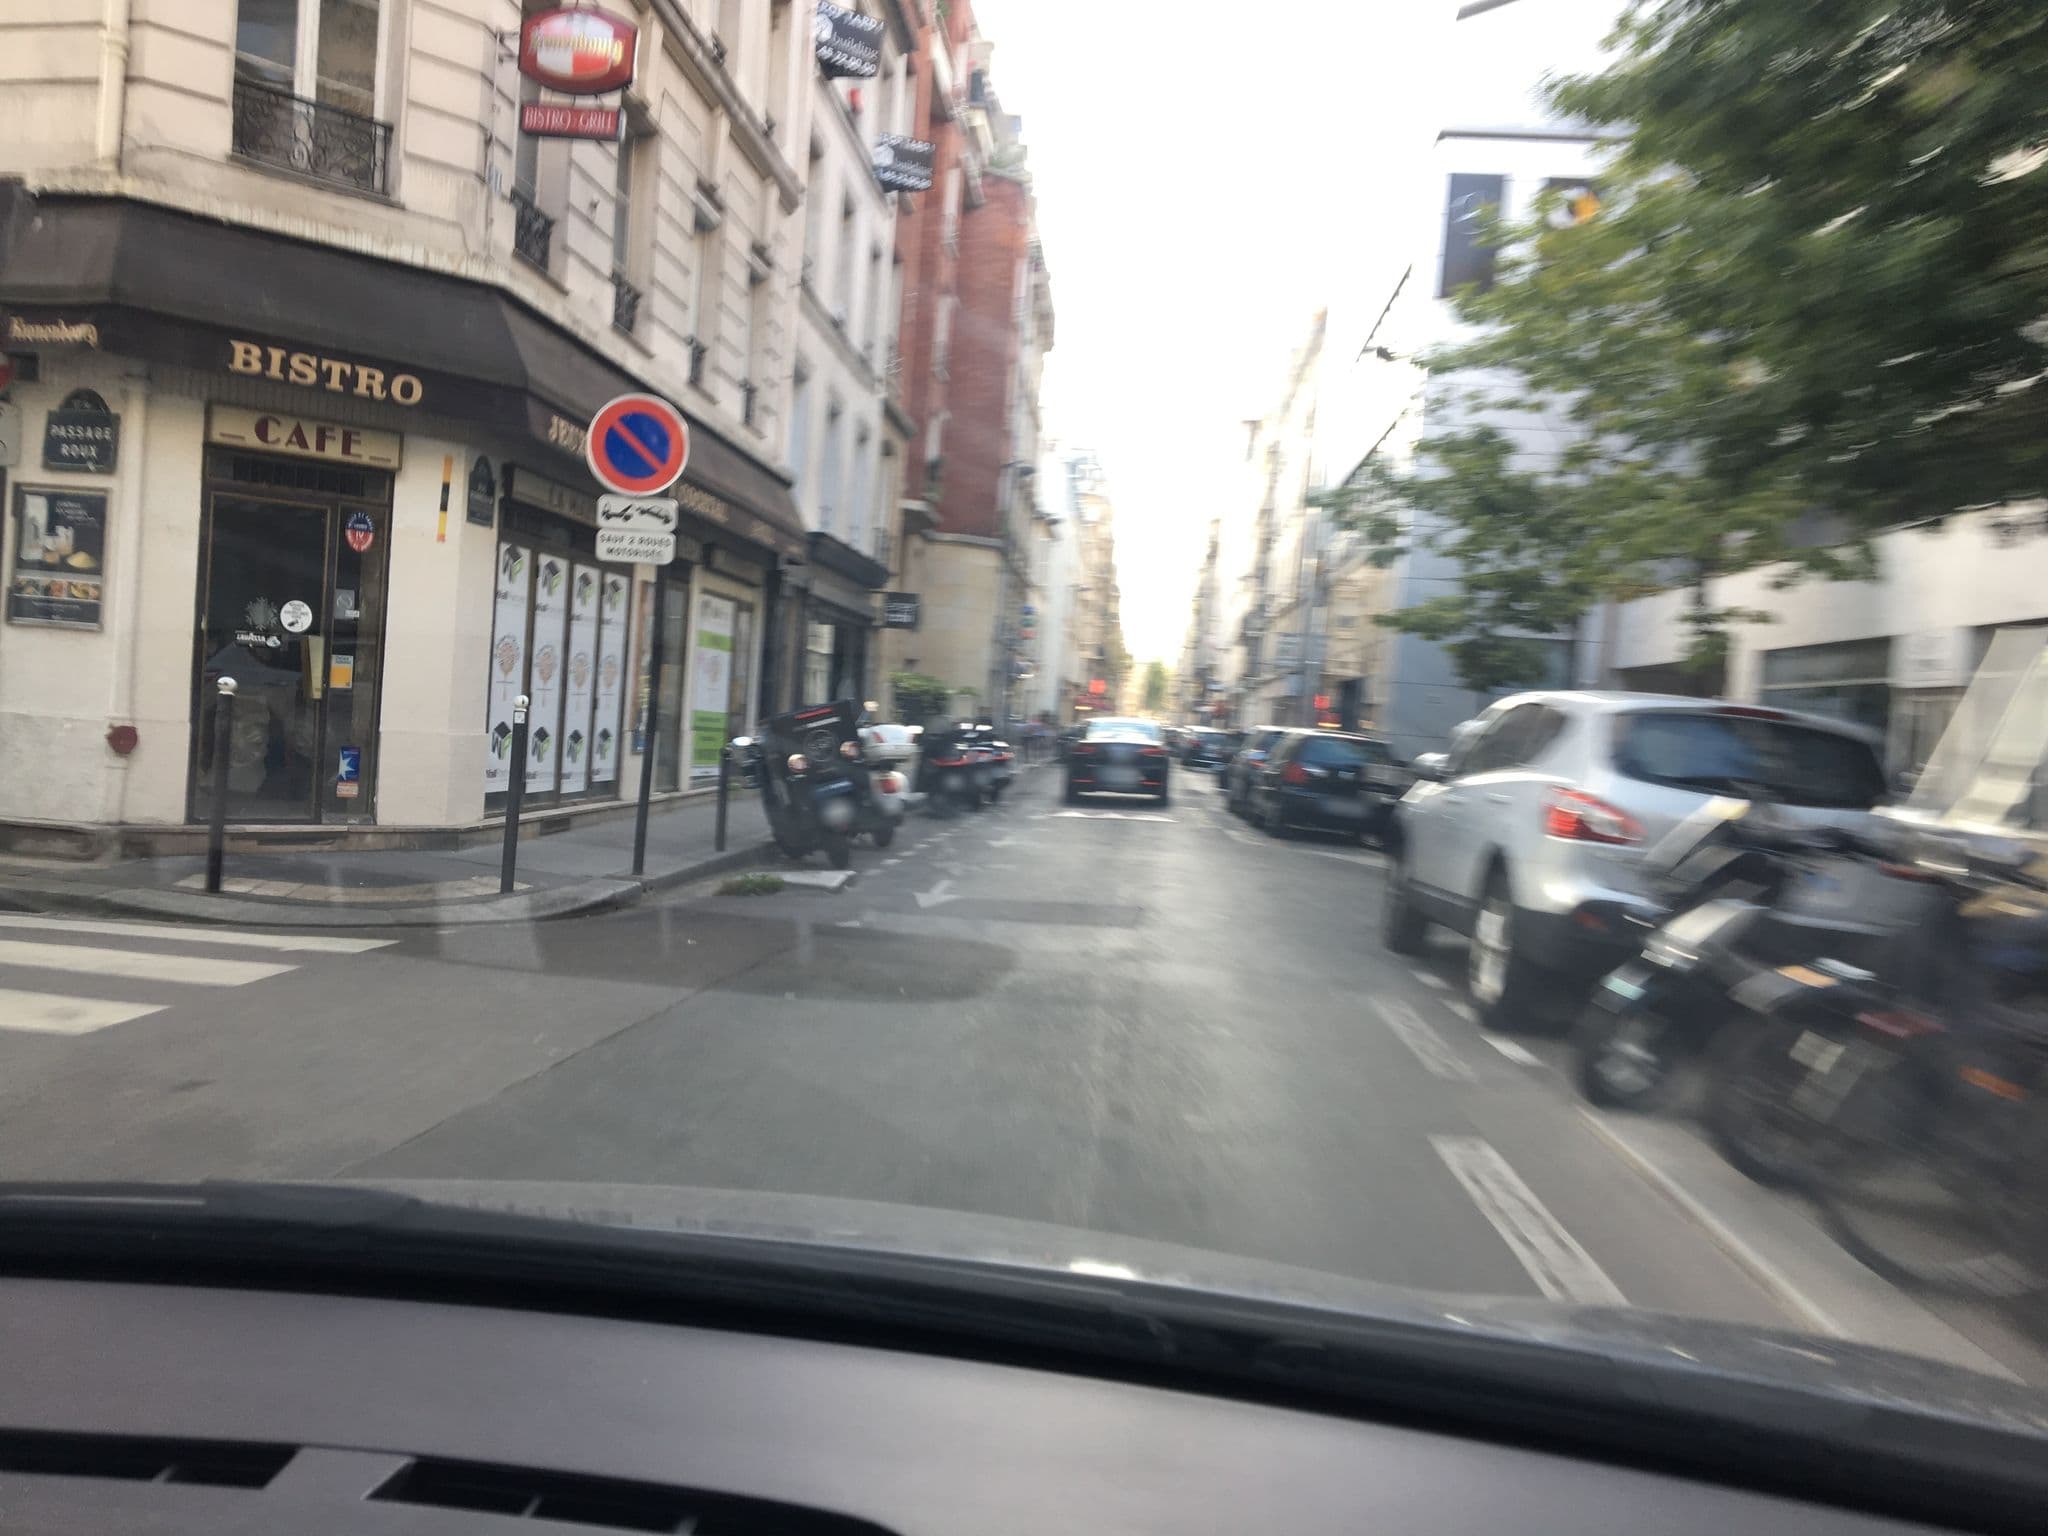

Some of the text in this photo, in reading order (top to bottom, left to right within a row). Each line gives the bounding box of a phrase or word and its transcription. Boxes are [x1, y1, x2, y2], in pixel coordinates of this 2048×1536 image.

[523, 106, 572, 131] BISTRO
[228, 339, 423, 406] BISTRO
[50, 424, 112, 440] PASSAGE
